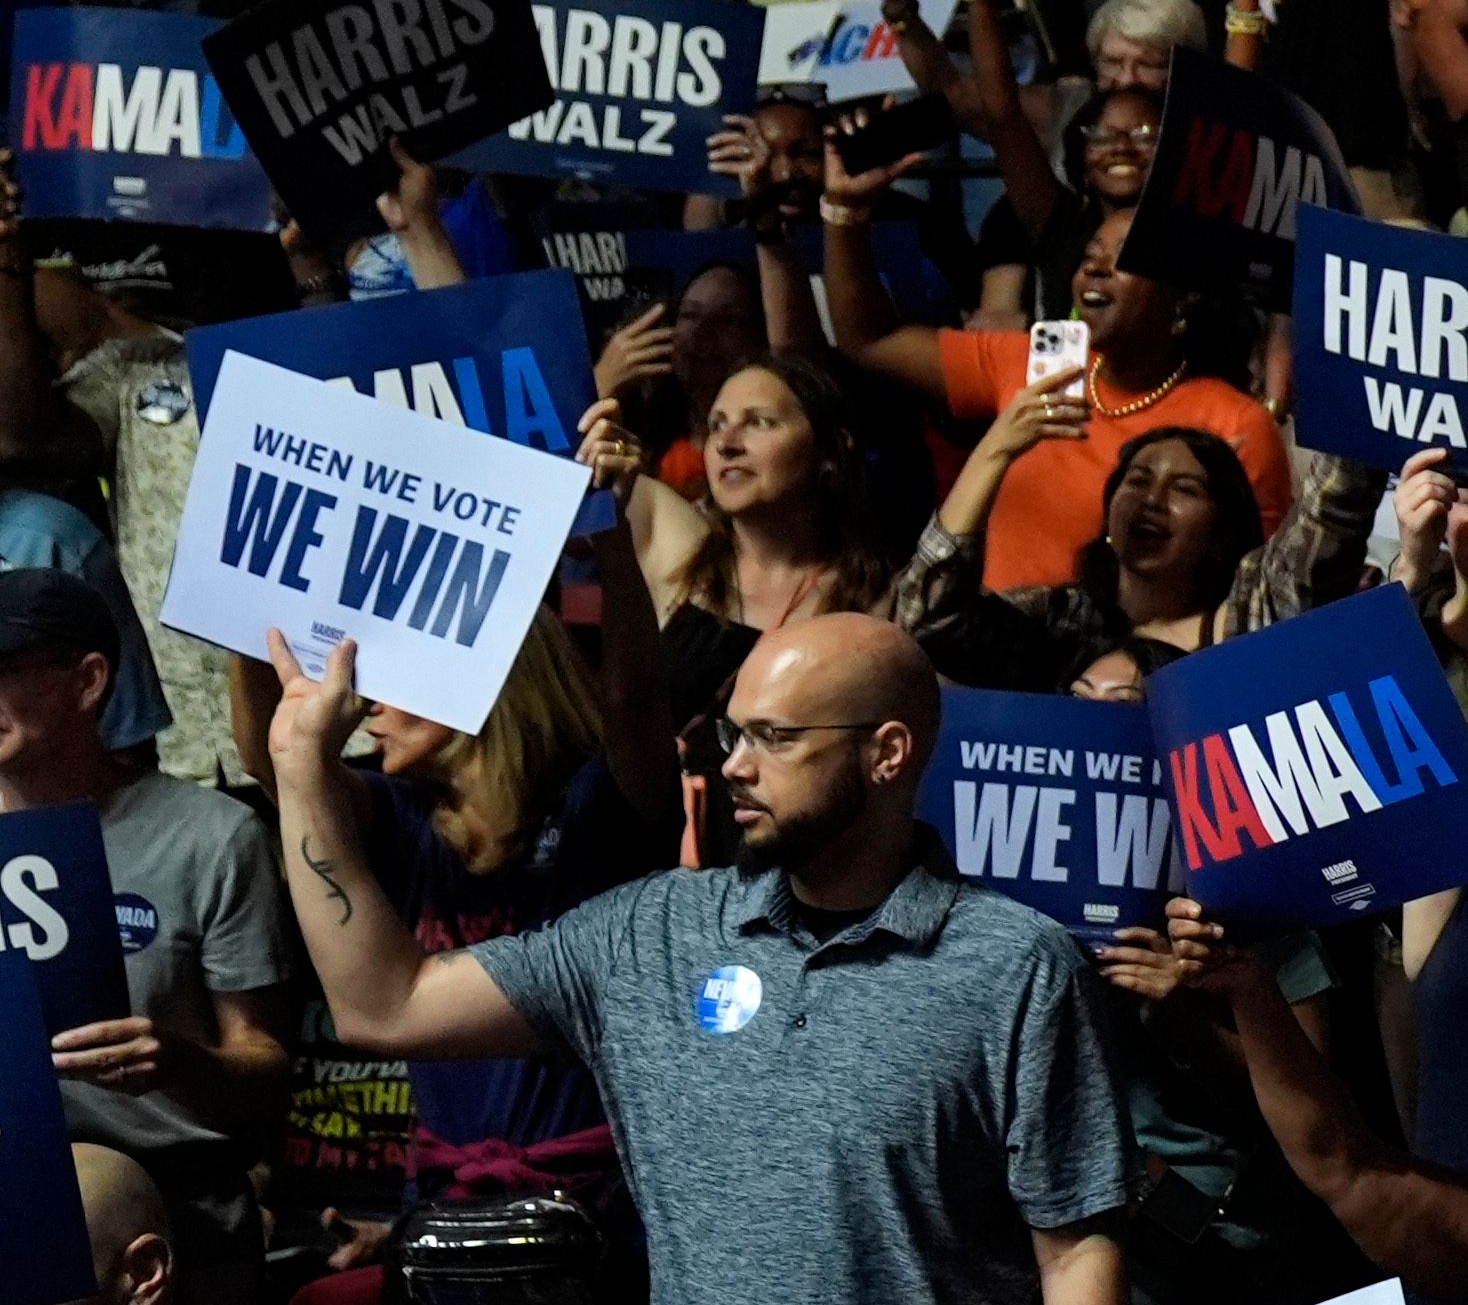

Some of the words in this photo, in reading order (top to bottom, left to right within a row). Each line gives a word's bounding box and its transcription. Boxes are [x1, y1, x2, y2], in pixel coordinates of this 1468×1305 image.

[322, 67, 472, 168] WALZ
[251, 423, 354, 483] WHEN
[363, 466, 423, 502] WE
[431, 489, 522, 536] VOTE
[219, 462, 337, 592] WE
[338, 505, 511, 648] WIN
[959, 740, 1076, 776] WHEN
[1084, 749, 1142, 783] WE
[1169, 674, 1459, 872] KAMALA
[952, 779, 1074, 883] WE
[1321, 859, 1358, 881] HARRIS
